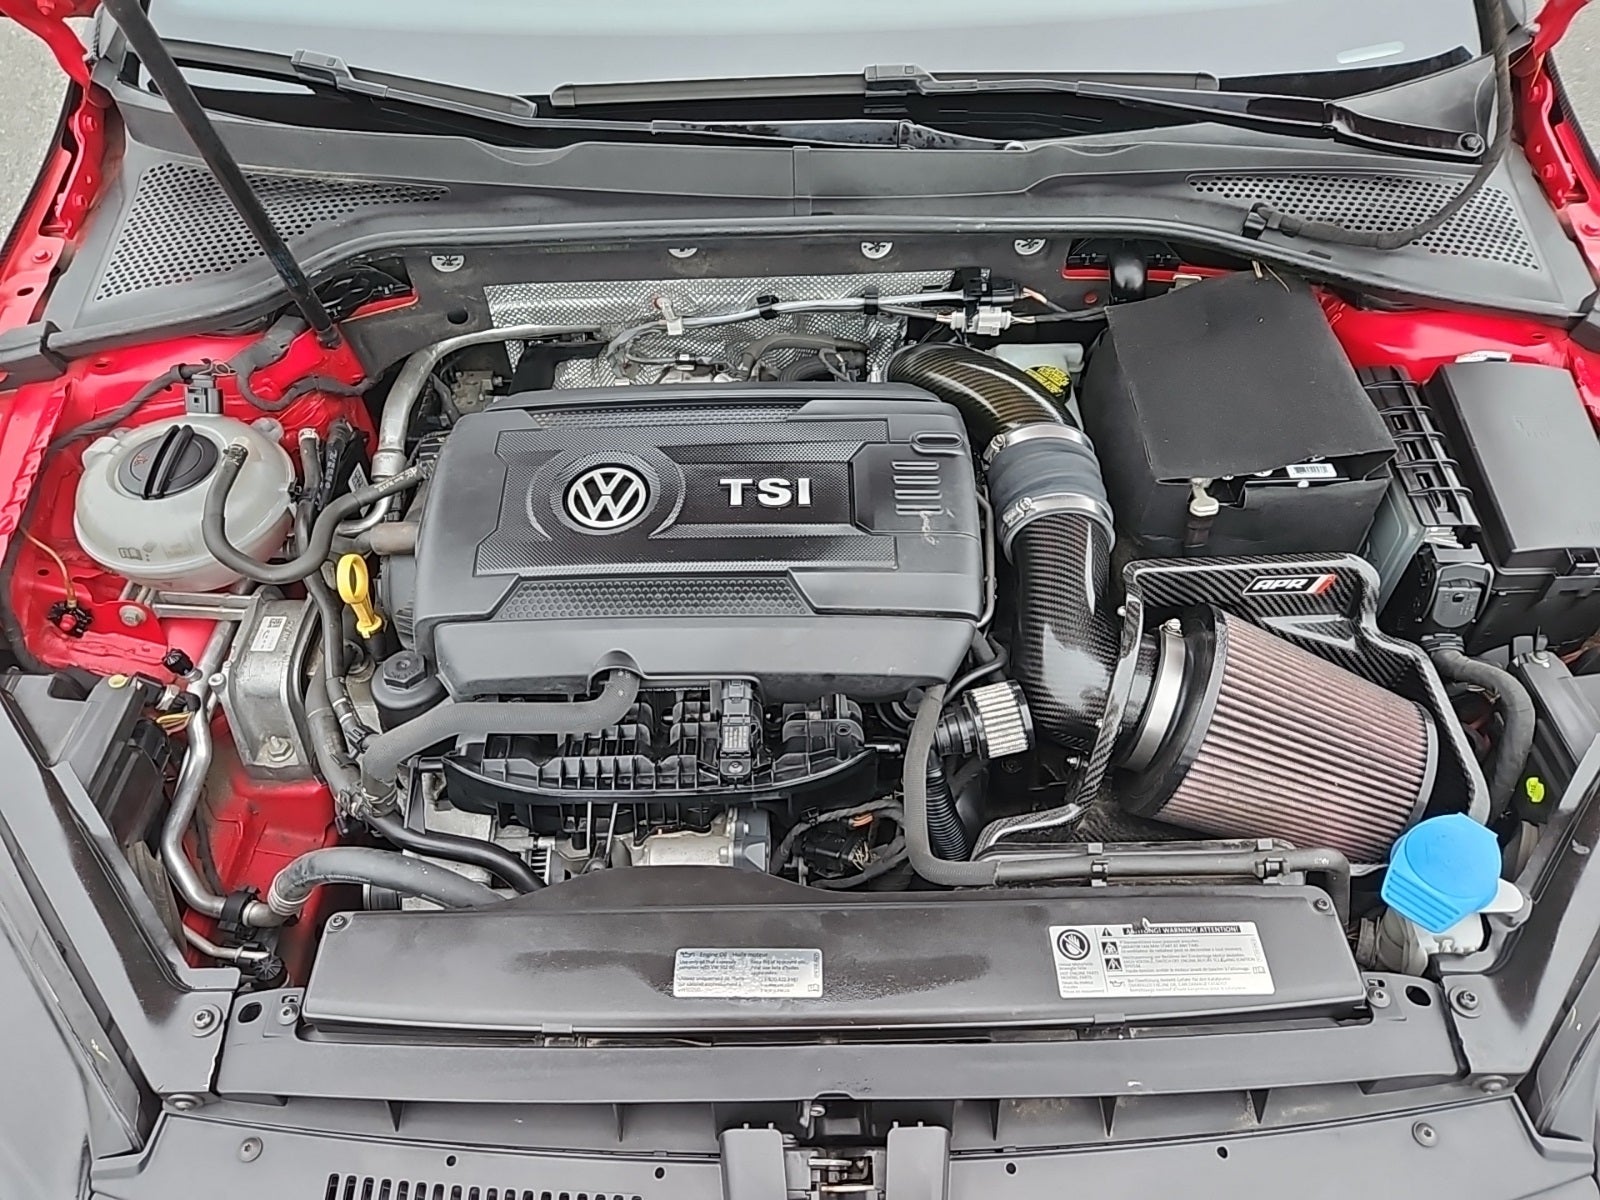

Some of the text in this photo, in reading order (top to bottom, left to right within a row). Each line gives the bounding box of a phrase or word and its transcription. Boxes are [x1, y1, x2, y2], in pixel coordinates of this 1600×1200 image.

[567, 466, 647, 529] VW
[719, 477, 812, 507] TSI
[1252, 578, 1310, 591] APR
[1162, 925, 1198, 935] WARNING!
[1199, 925, 1240, 934] ATTENTION!
[699, 951, 719, 959] Engine
